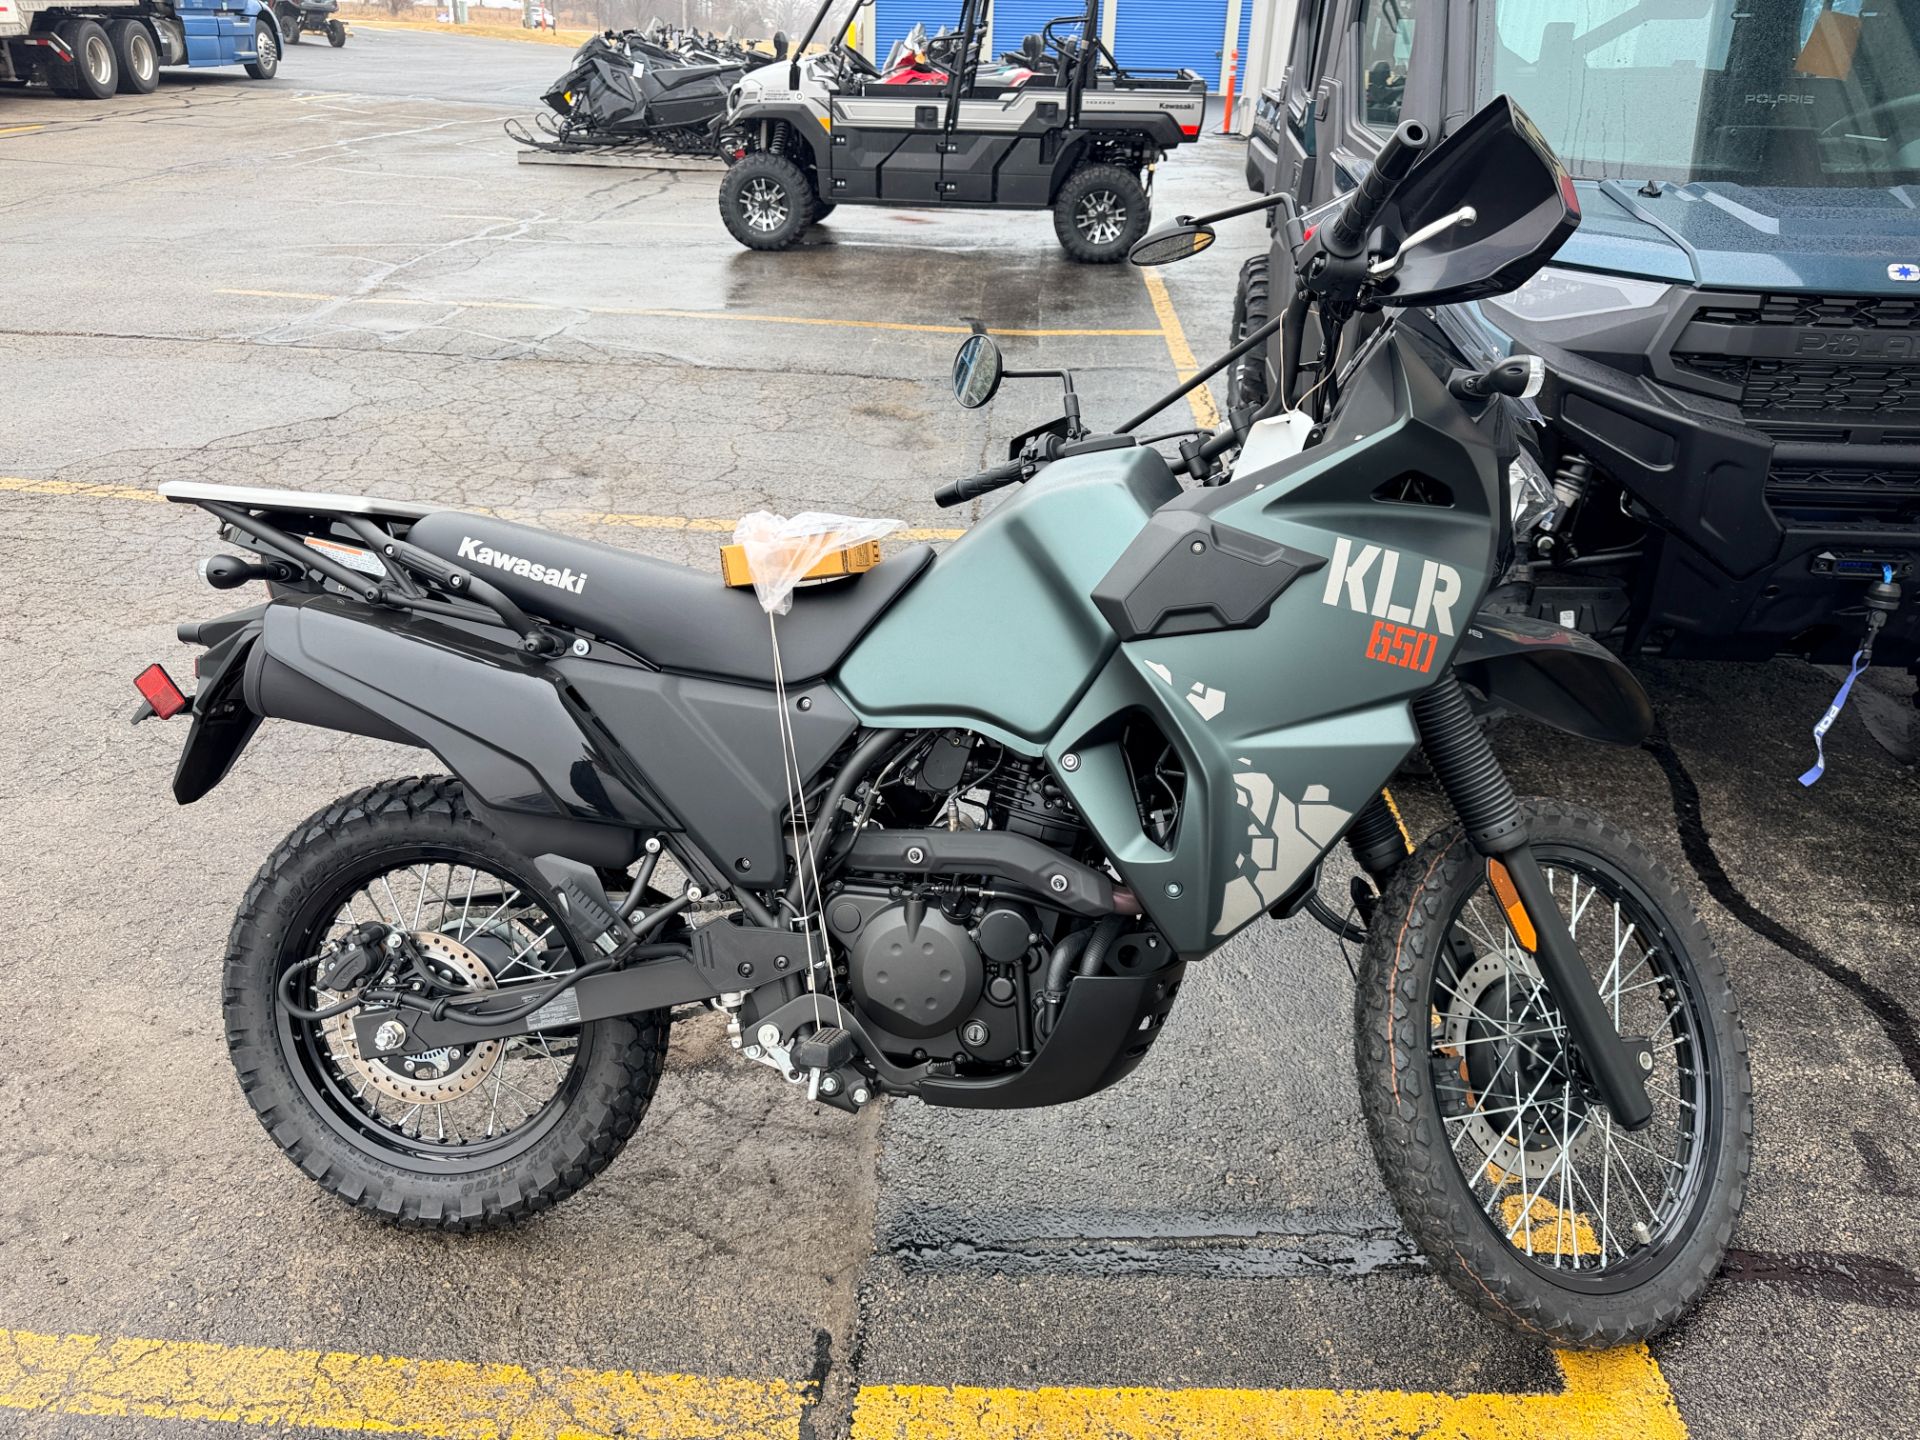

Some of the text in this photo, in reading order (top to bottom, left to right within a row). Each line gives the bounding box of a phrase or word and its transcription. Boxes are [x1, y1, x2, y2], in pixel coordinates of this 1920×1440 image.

[1159, 102, 1195, 110] Kawasaki
[1745, 94, 1816, 105] POLARIS
[457, 536, 588, 595] Kawasaki
[1322, 536, 1462, 637] KLR
[1365, 620, 1438, 673] 650
